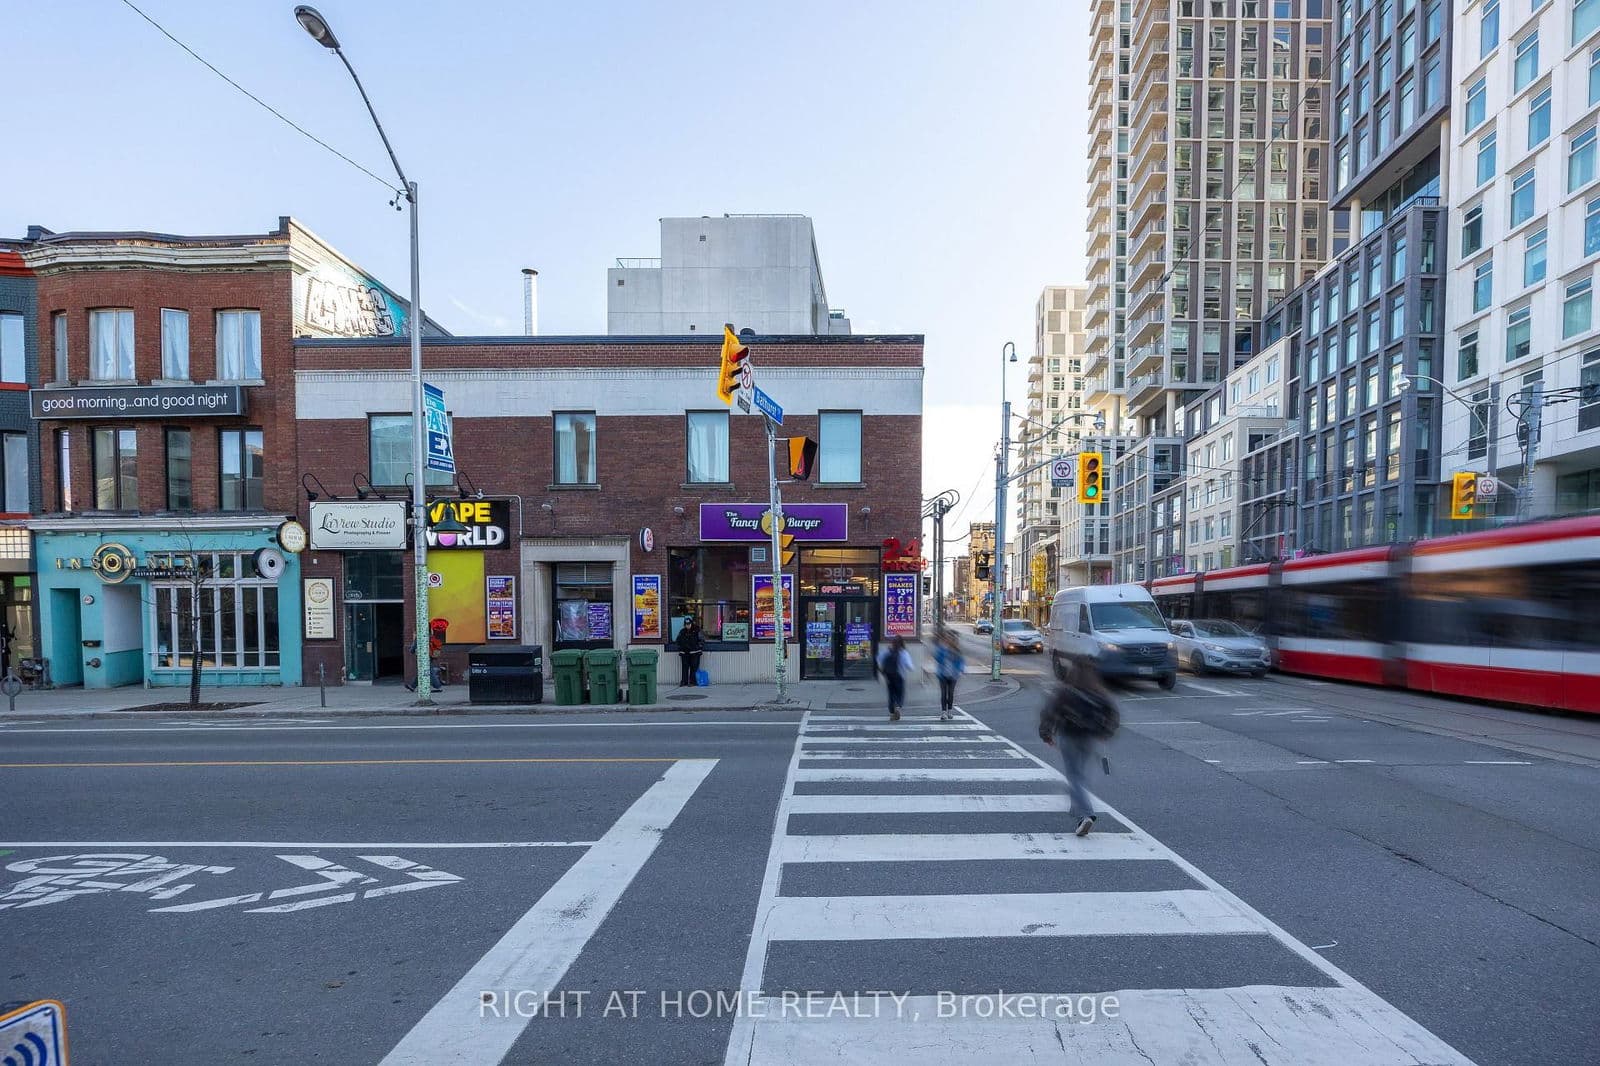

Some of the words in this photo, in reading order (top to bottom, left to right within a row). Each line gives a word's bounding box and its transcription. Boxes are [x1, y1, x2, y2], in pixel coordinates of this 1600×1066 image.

[42, 397, 74, 412] good
[162, 393, 195, 410] good
[198, 392, 228, 409] night
[756, 389, 778, 418] Bathurst
[361, 516, 396, 529] Studio
[730, 517, 759, 530] Fancy
[786, 517, 821, 530] Burger
[882, 538, 920, 560] 24
[821, 585, 843, 593] OPEN
